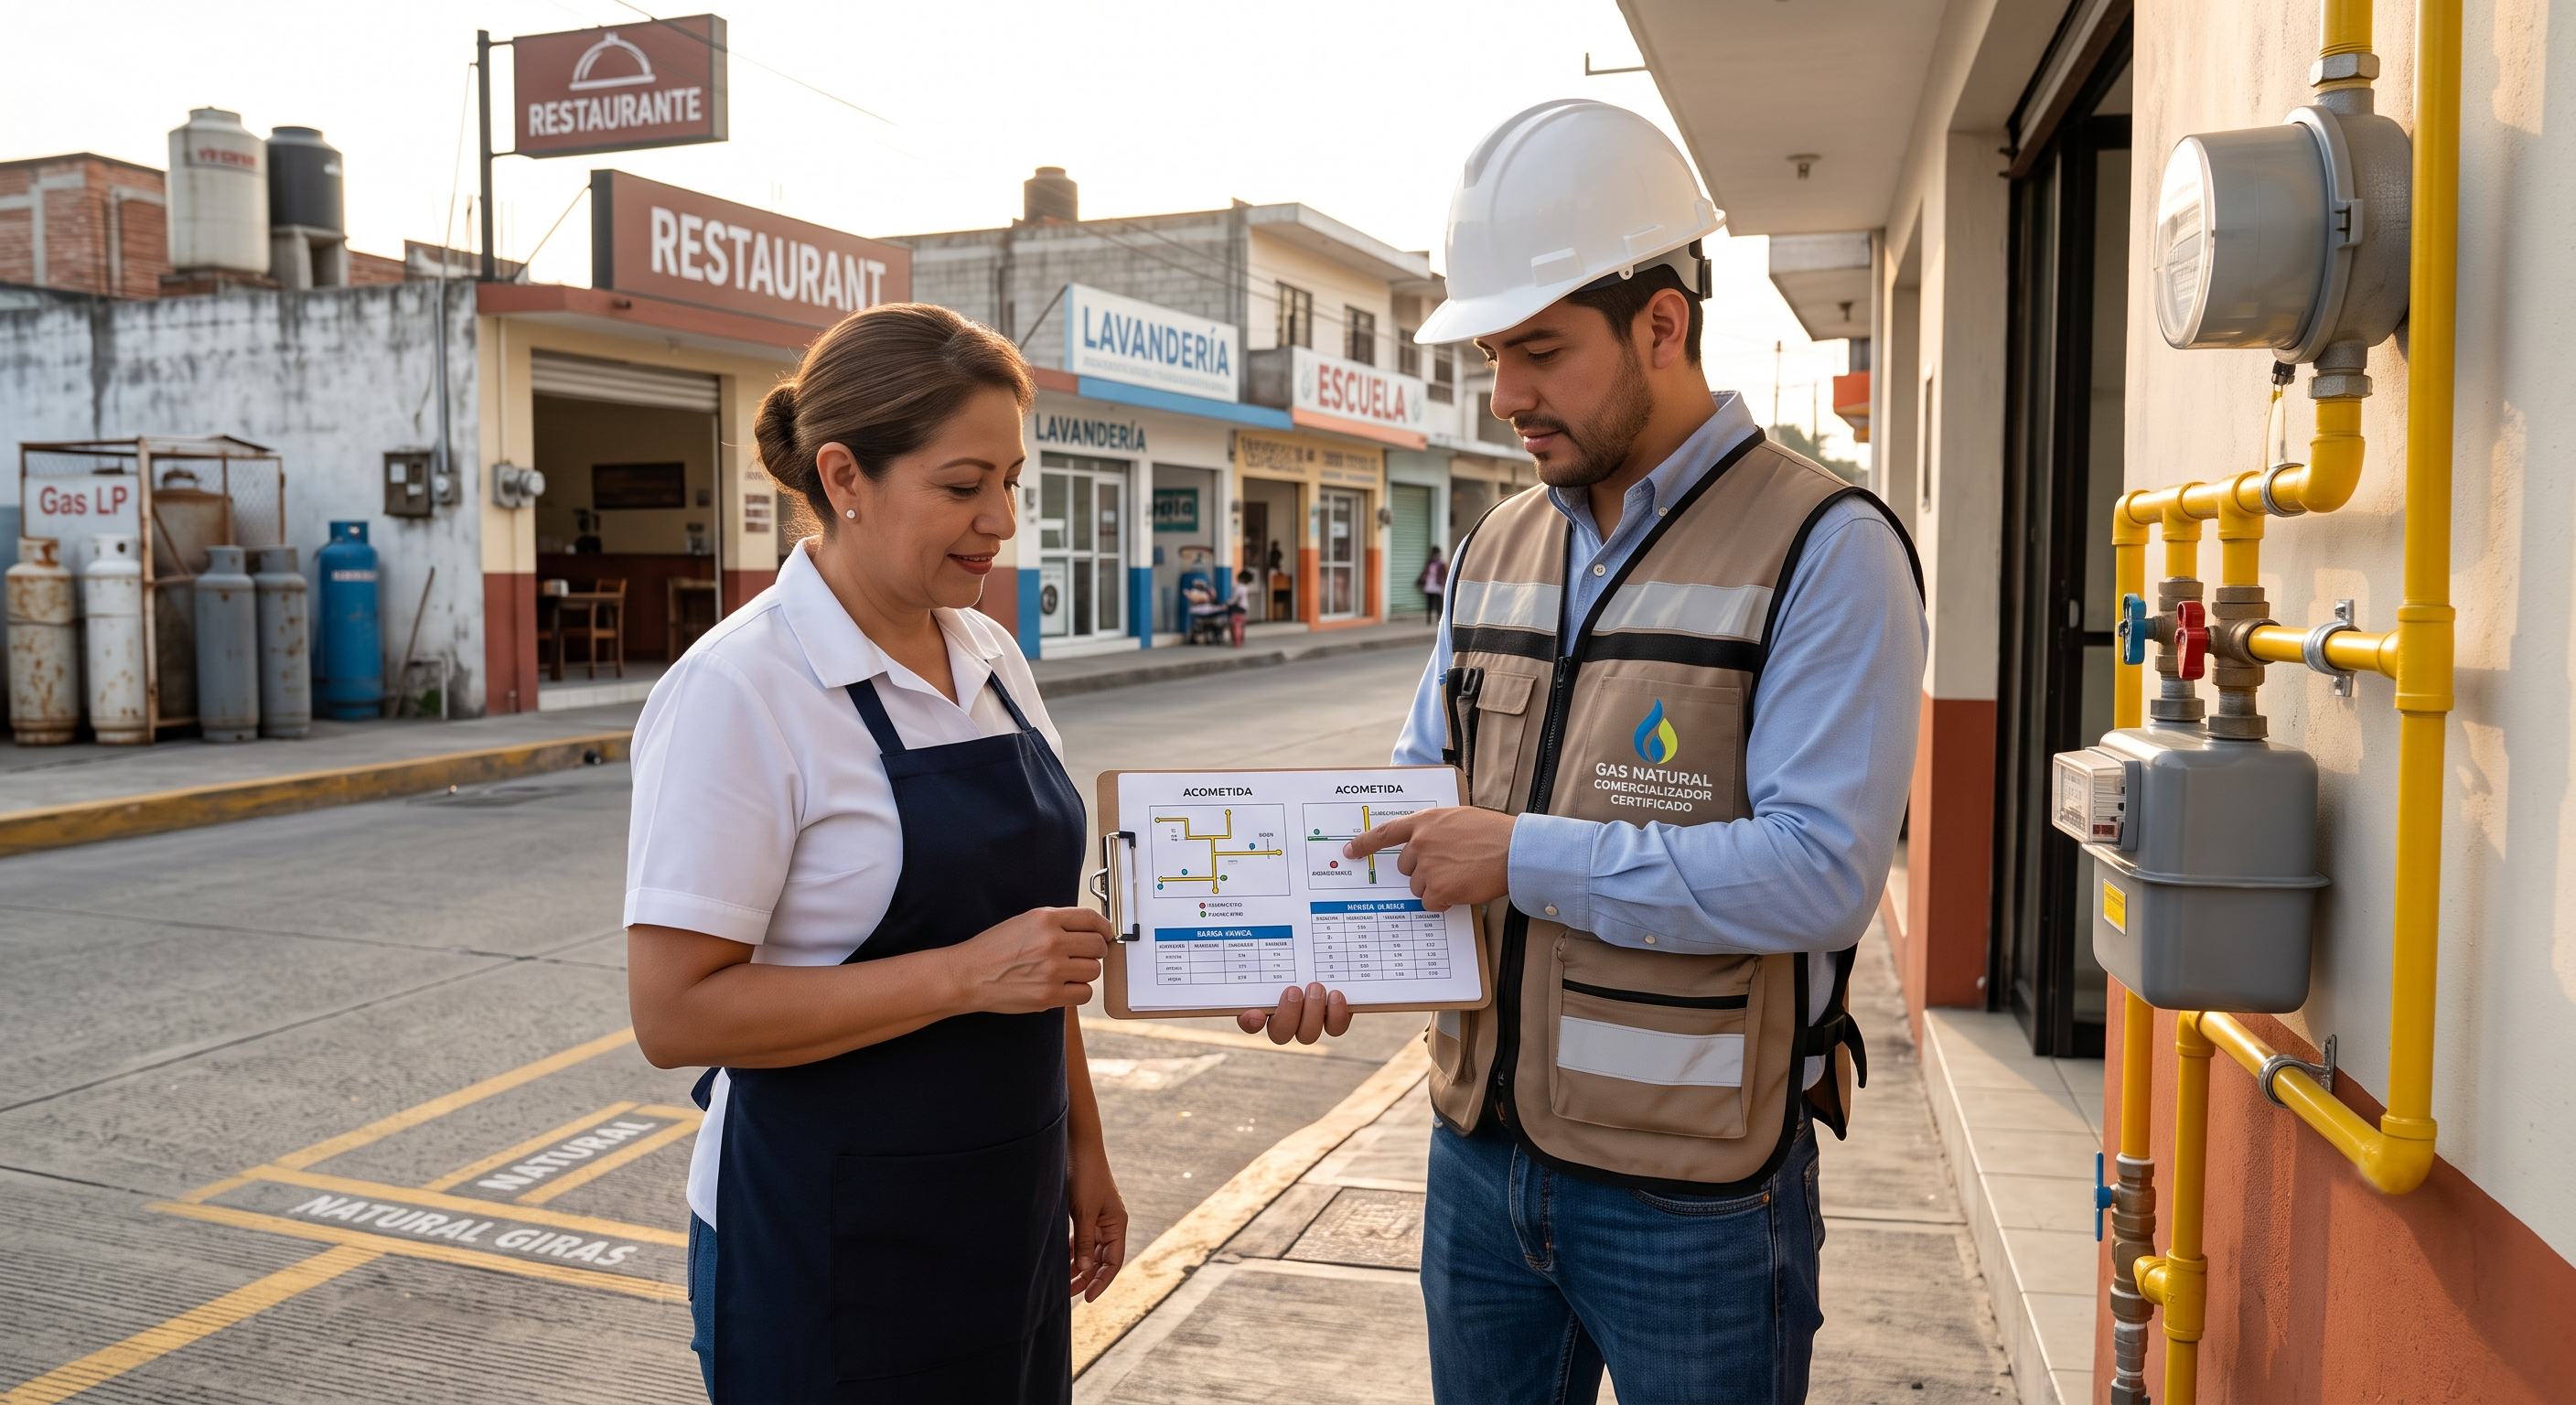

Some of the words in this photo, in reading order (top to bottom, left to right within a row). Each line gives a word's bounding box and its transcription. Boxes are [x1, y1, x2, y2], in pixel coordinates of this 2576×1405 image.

[529, 86, 702, 137] RESTAURANTE
[650, 206, 886, 315] RESTAURANT
[1083, 305, 1230, 377] LAVANDERÍA
[1318, 363, 1407, 424] ESCUELA
[1035, 413, 1147, 453] LAVANDERÍA
[40, 486, 88, 516] Gas
[96, 485, 128, 515] LP
[1183, 787, 1253, 798] ACOMETIDA
[1335, 784, 1404, 795] ACOMETIDA
[1594, 778, 1712, 801] COMERCIALIZADOR
[1595, 762, 1628, 778] GAS
[1632, 767, 1713, 788] NATURAL
[1610, 794, 1693, 812] CERTIFICADO
[477, 1121, 657, 1191] NATURAL
[287, 1195, 495, 1243] NATURAL
[494, 1228, 639, 1266] GIRAS
